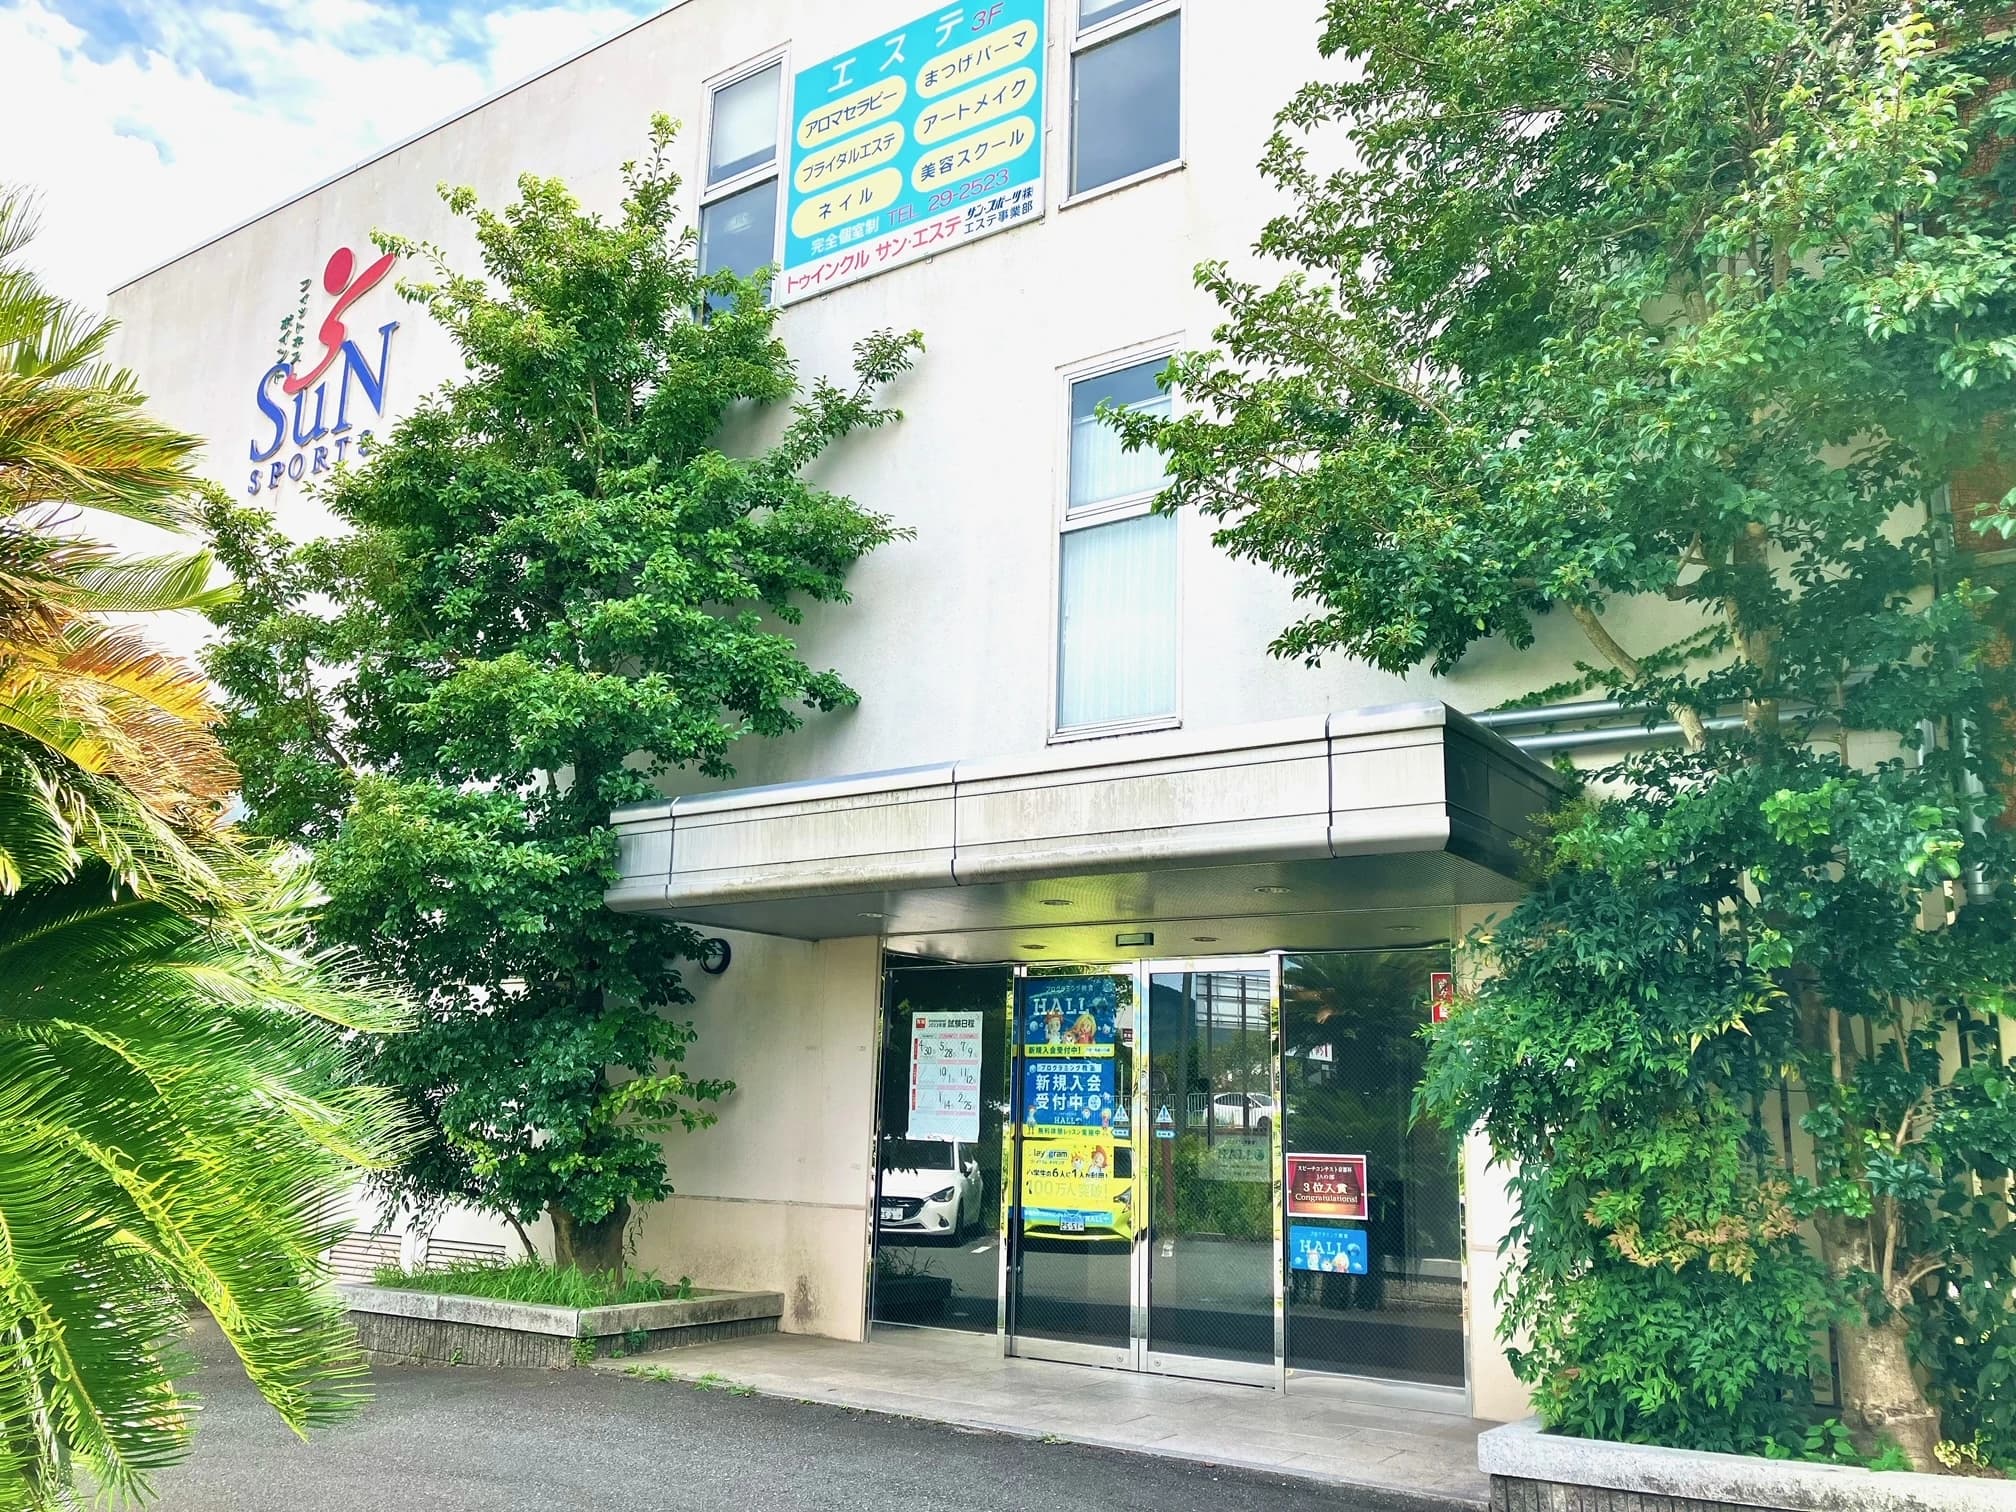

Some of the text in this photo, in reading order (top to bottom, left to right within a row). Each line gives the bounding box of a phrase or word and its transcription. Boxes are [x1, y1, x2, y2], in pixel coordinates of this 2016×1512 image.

[827, 1, 1005, 92] エステ 3F
[923, 78, 1026, 134] アートメイク
[920, 128, 1025, 182] 美容スクール
[818, 187, 873, 220] ネイル
[887, 167, 1010, 226] TEL 29-2523
[963, 199, 1034, 235] エステ事業部
[787, 249, 870, 295] トゥインクル
[1035, 1074, 1102, 1092] 新規入会
[1035, 1092, 1083, 1111] 受付中
